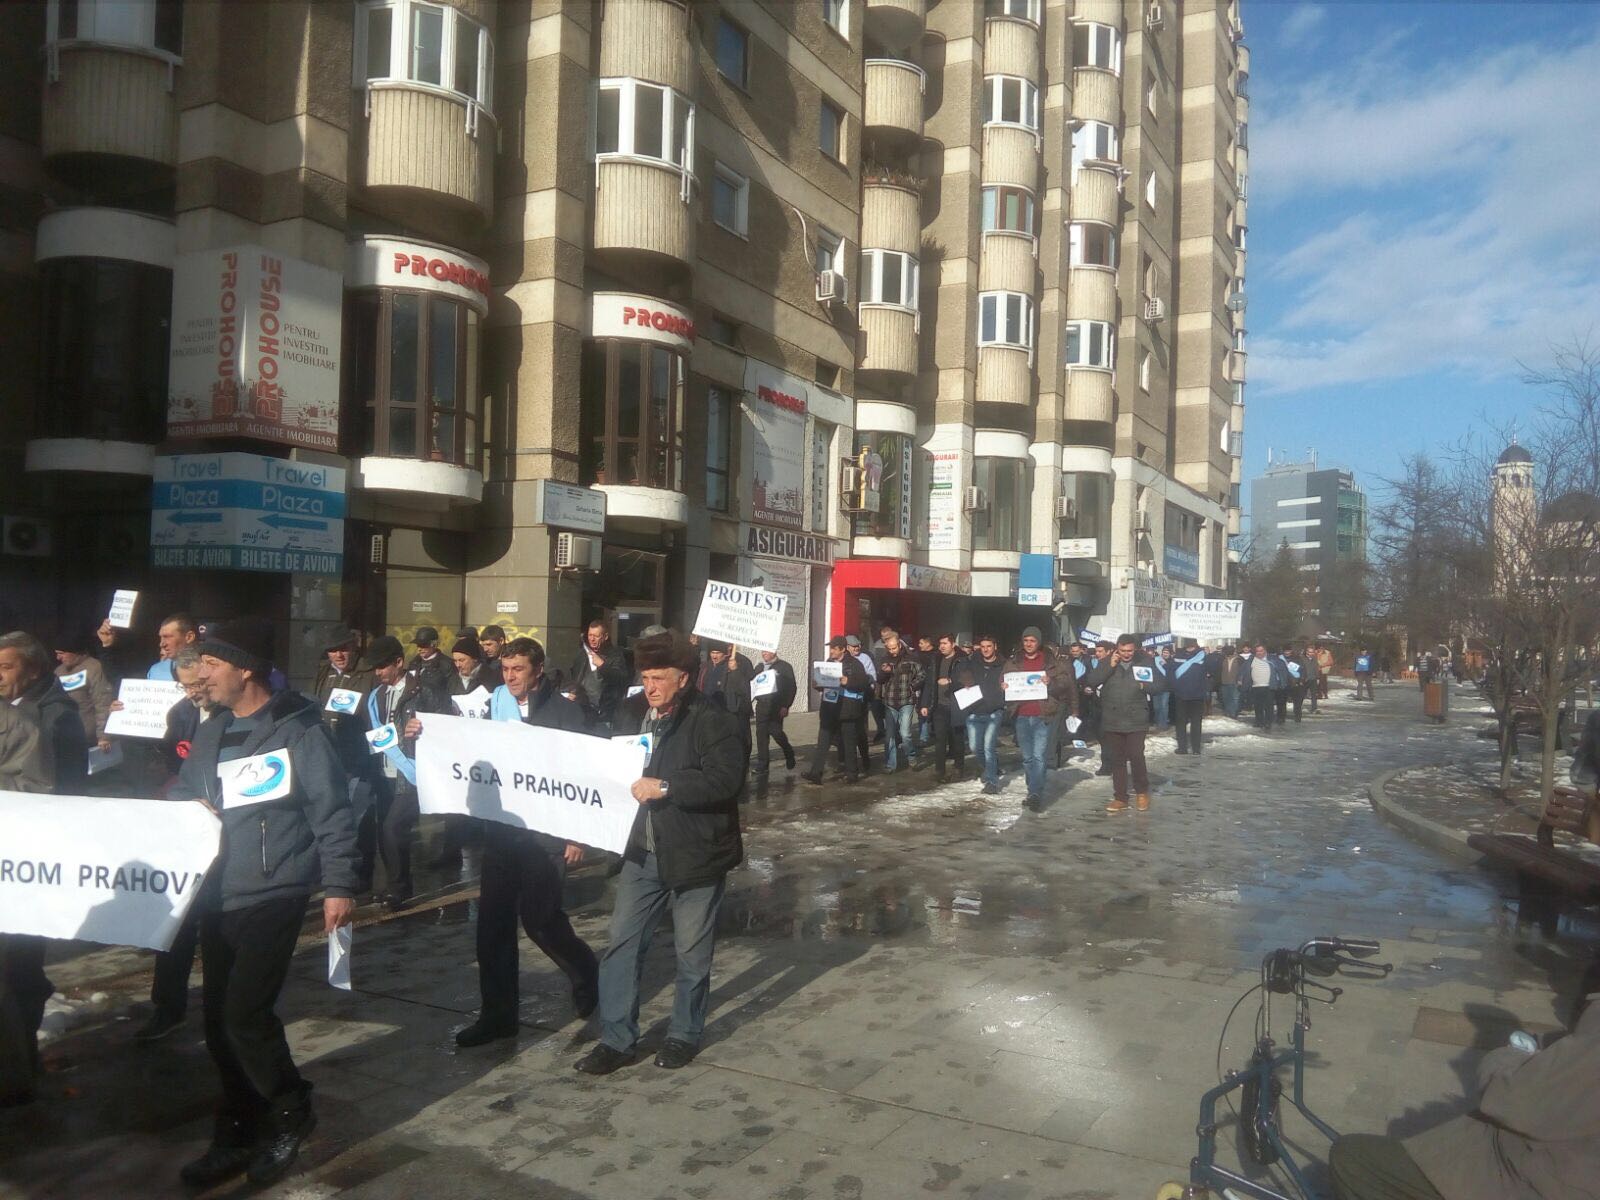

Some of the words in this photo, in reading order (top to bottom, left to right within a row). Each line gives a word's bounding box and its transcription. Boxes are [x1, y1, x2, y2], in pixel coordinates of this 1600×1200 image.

[213, 252, 238, 417] PROHOUSE
[255, 255, 282, 420] PROHOUSE
[283, 323, 320, 340] PENTRU
[283, 335, 329, 355] INVESTITII
[282, 350, 337, 371] IMOBILIARE
[247, 422, 284, 438] AGENTIE
[286, 430, 338, 448] IMOBILIARA
[170, 456, 223, 478] Travel
[926, 453, 959, 462] ASIGURARI
[261, 457, 327, 488] Travel
[169, 484, 219, 506] Plaza
[262, 486, 324, 514] Plaza
[902, 440, 911, 536] ASIGURARI
[748, 527, 830, 562] ASIGURARI
[154, 549, 186, 567] BILETE
[187, 549, 200, 567] DE
[201, 549, 232, 567] AVION
[240, 550, 282, 570] BILETE
[285, 553, 301, 570] DE
[303, 554, 337, 573] AVION
[708, 584, 787, 612] PROTEST
[1021, 593, 1038, 602] BCR
[1174, 600, 1243, 613] PROTEST
[452, 762, 503, 787] S.G.A
[513, 771, 604, 809] PRAHOVA
[0, 859, 62, 886] ROM
